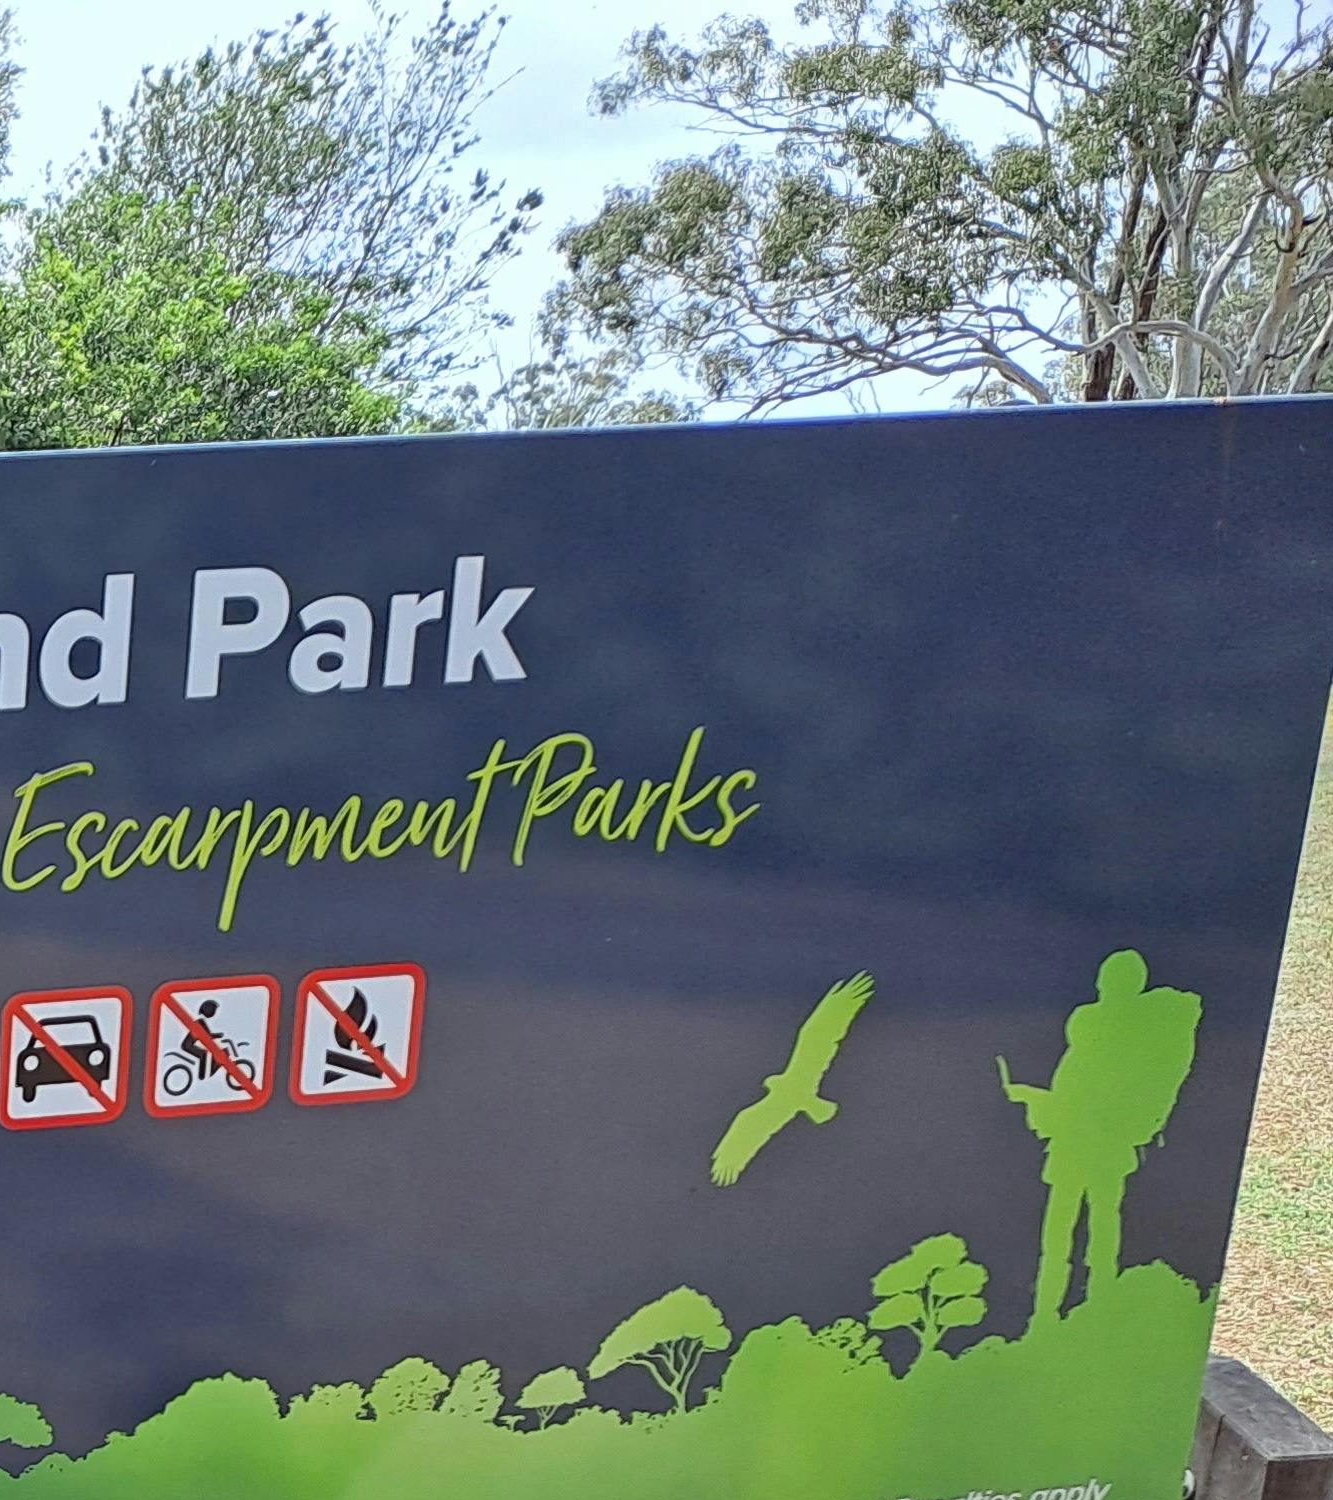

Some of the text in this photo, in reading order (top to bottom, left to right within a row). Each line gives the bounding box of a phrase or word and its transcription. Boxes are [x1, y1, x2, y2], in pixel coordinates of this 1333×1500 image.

[184, 555, 535, 700] Park
[0, 738, 525, 931] Escarpment
[511, 726, 761, 867] Parks
